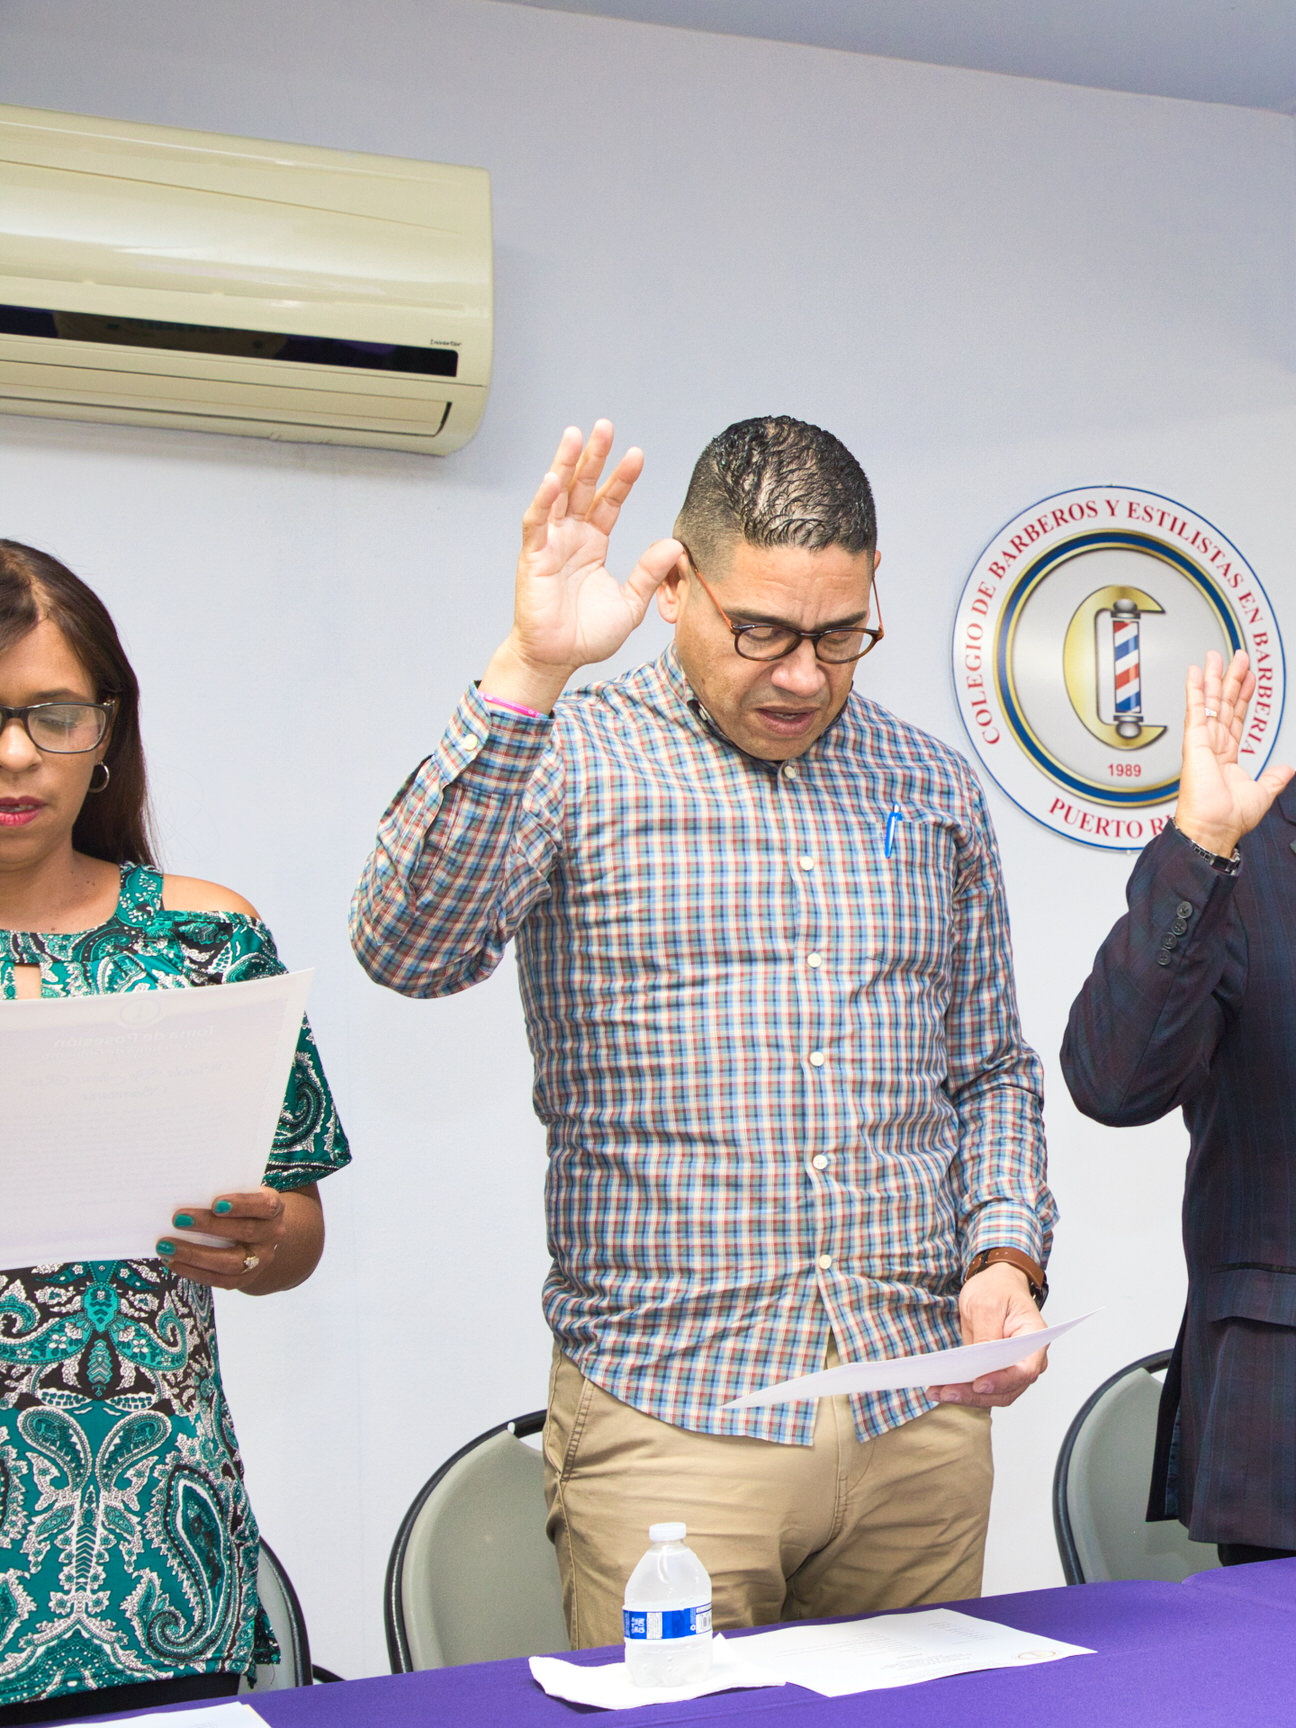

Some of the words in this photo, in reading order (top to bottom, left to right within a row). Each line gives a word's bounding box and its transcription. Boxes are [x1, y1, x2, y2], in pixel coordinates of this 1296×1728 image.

[1104, 499, 1120, 517] Y
[988, 500, 1098, 580] BARBEROS
[1127, 501, 1244, 589] ESTILISTAS
[971, 581, 996, 616] DE
[1238, 592, 1262, 625] EN
[965, 622, 1000, 745] COLEGIO
[1240, 632, 1273, 755] BARBERIA
[1108, 763, 1142, 777] 1989
[1049, 797, 1143, 838] PUERTO
